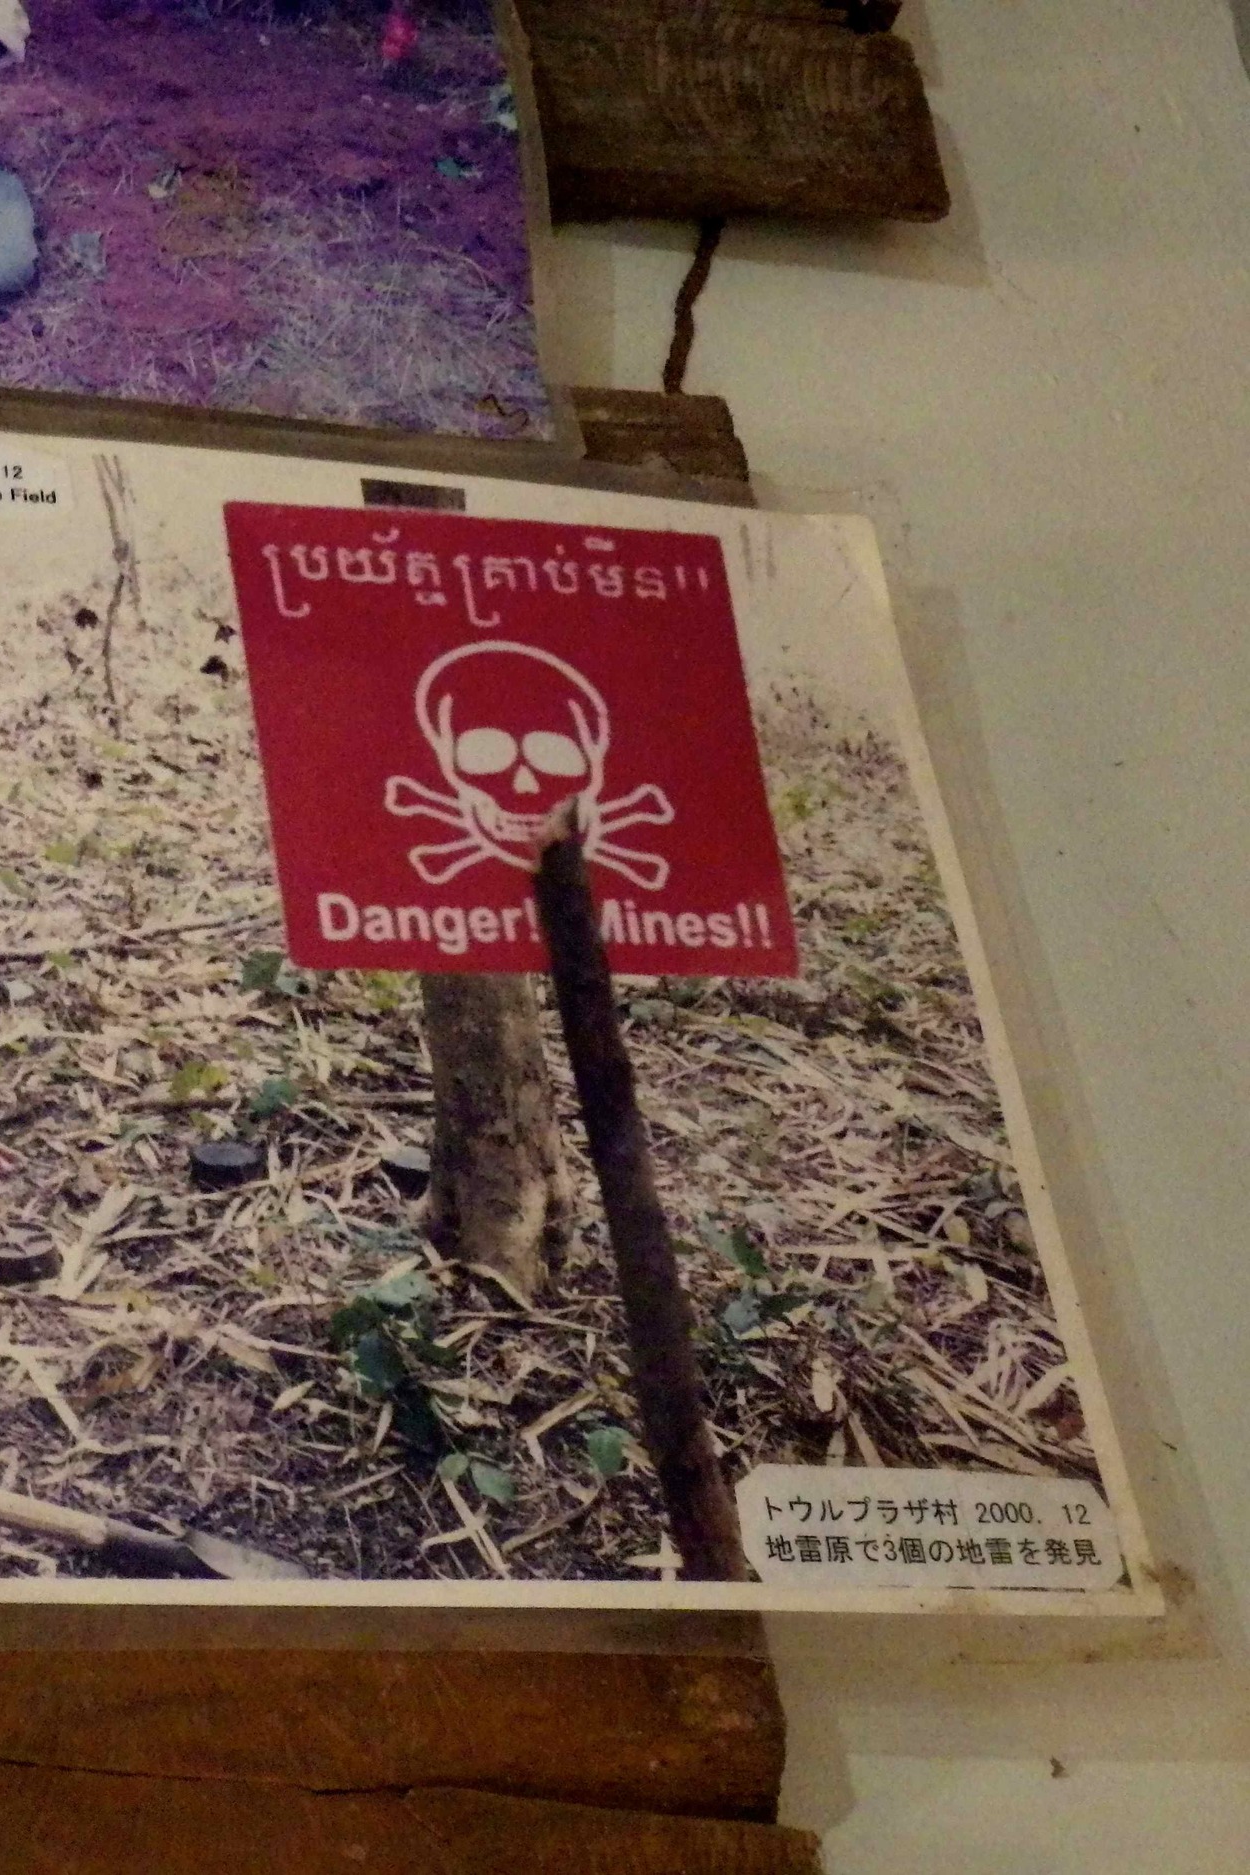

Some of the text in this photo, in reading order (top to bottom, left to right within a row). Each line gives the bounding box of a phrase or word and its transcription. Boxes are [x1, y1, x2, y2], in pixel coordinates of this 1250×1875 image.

[2, 464, 23, 480] 12
[10, 488, 57, 505] Field
[764, 1495, 1092, 1527] トウルプラザ村 2000. 12
[765, 1533, 1103, 1567] 地雷原で3個の地雷を発見
